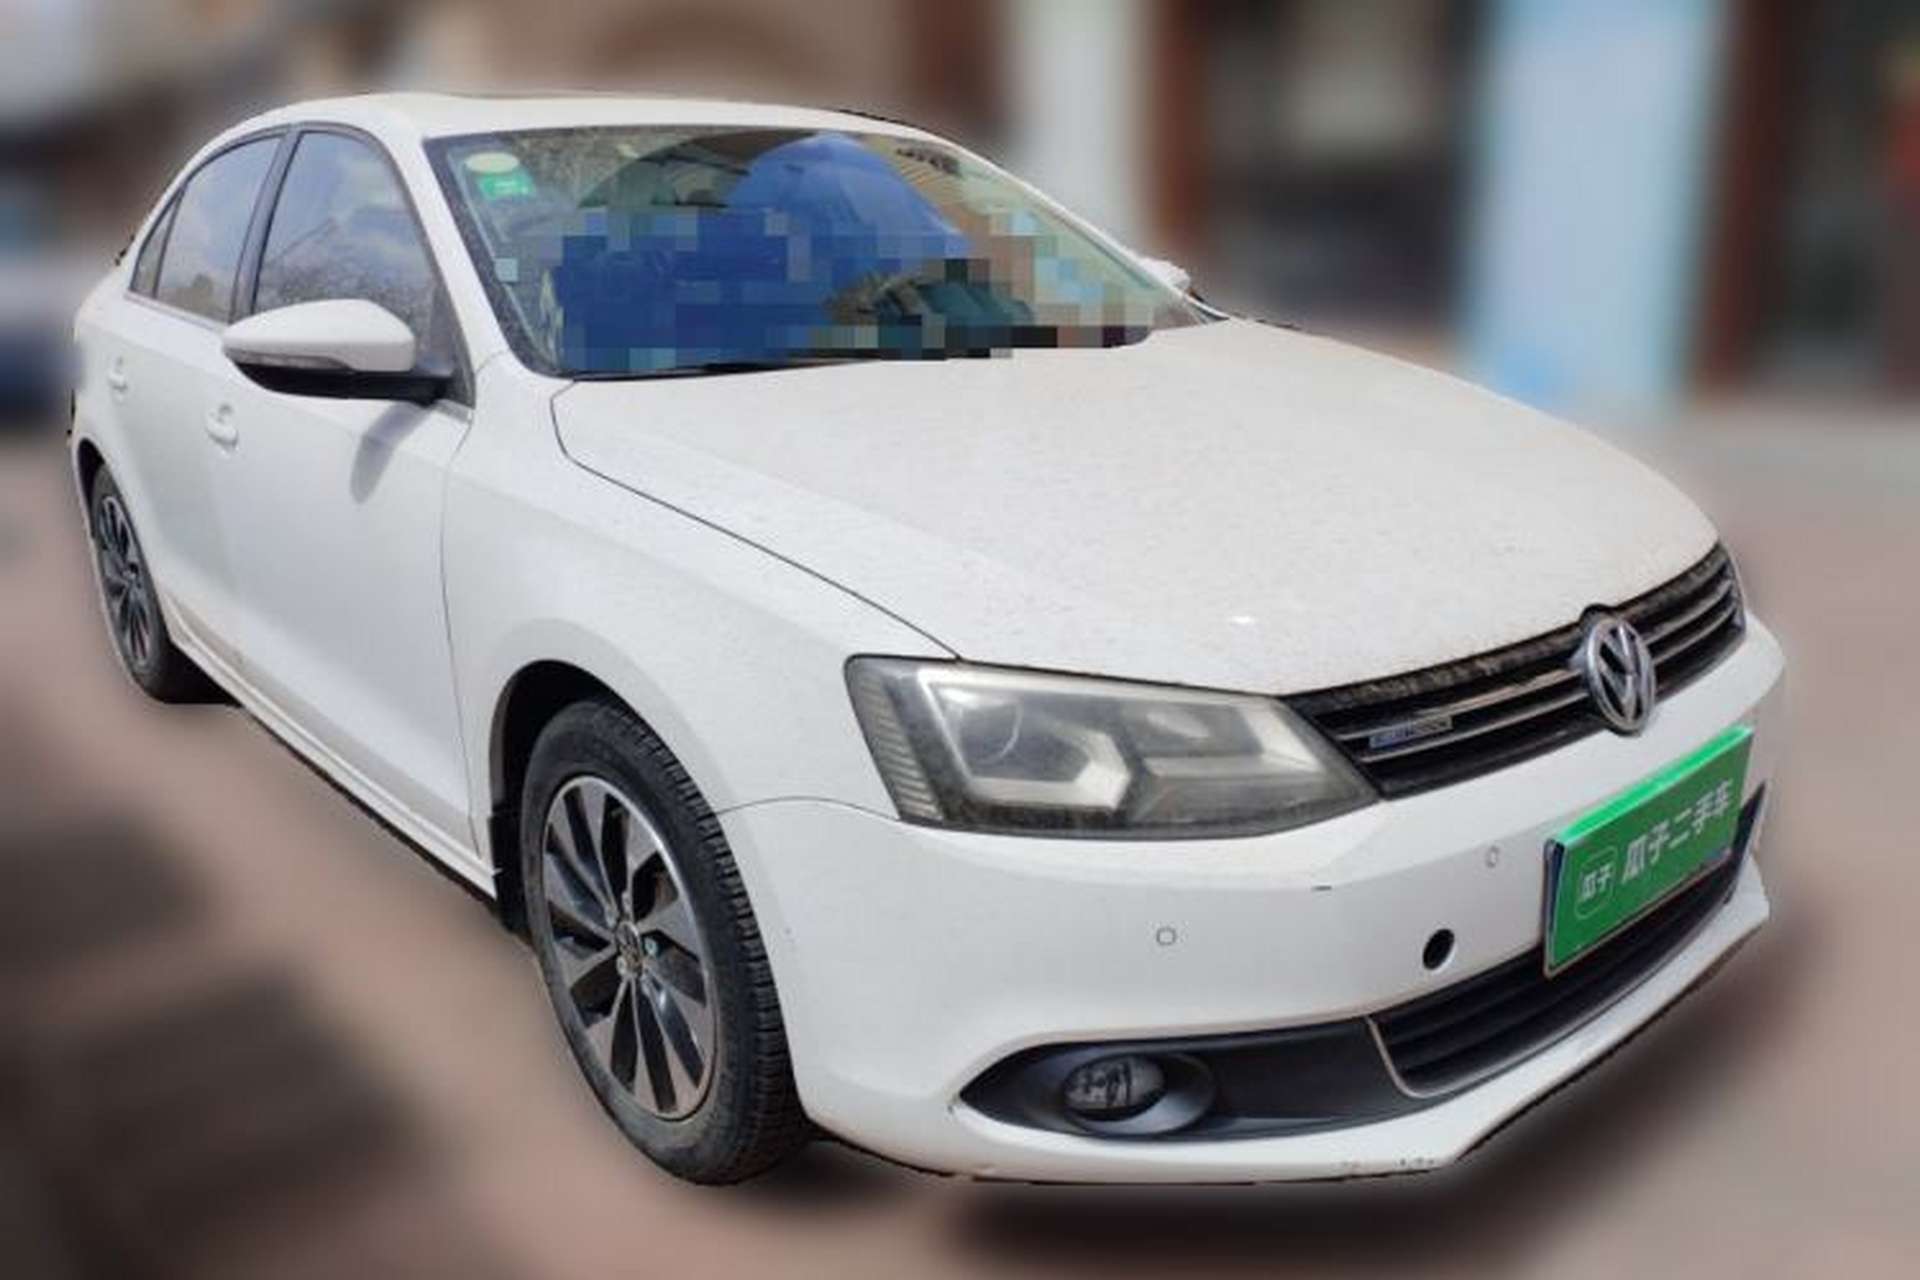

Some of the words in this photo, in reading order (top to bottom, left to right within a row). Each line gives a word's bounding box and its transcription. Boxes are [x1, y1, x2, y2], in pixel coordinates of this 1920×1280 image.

[1622, 778, 1733, 883] 瓜子二手车
[1578, 862, 1616, 902] 瓜子
